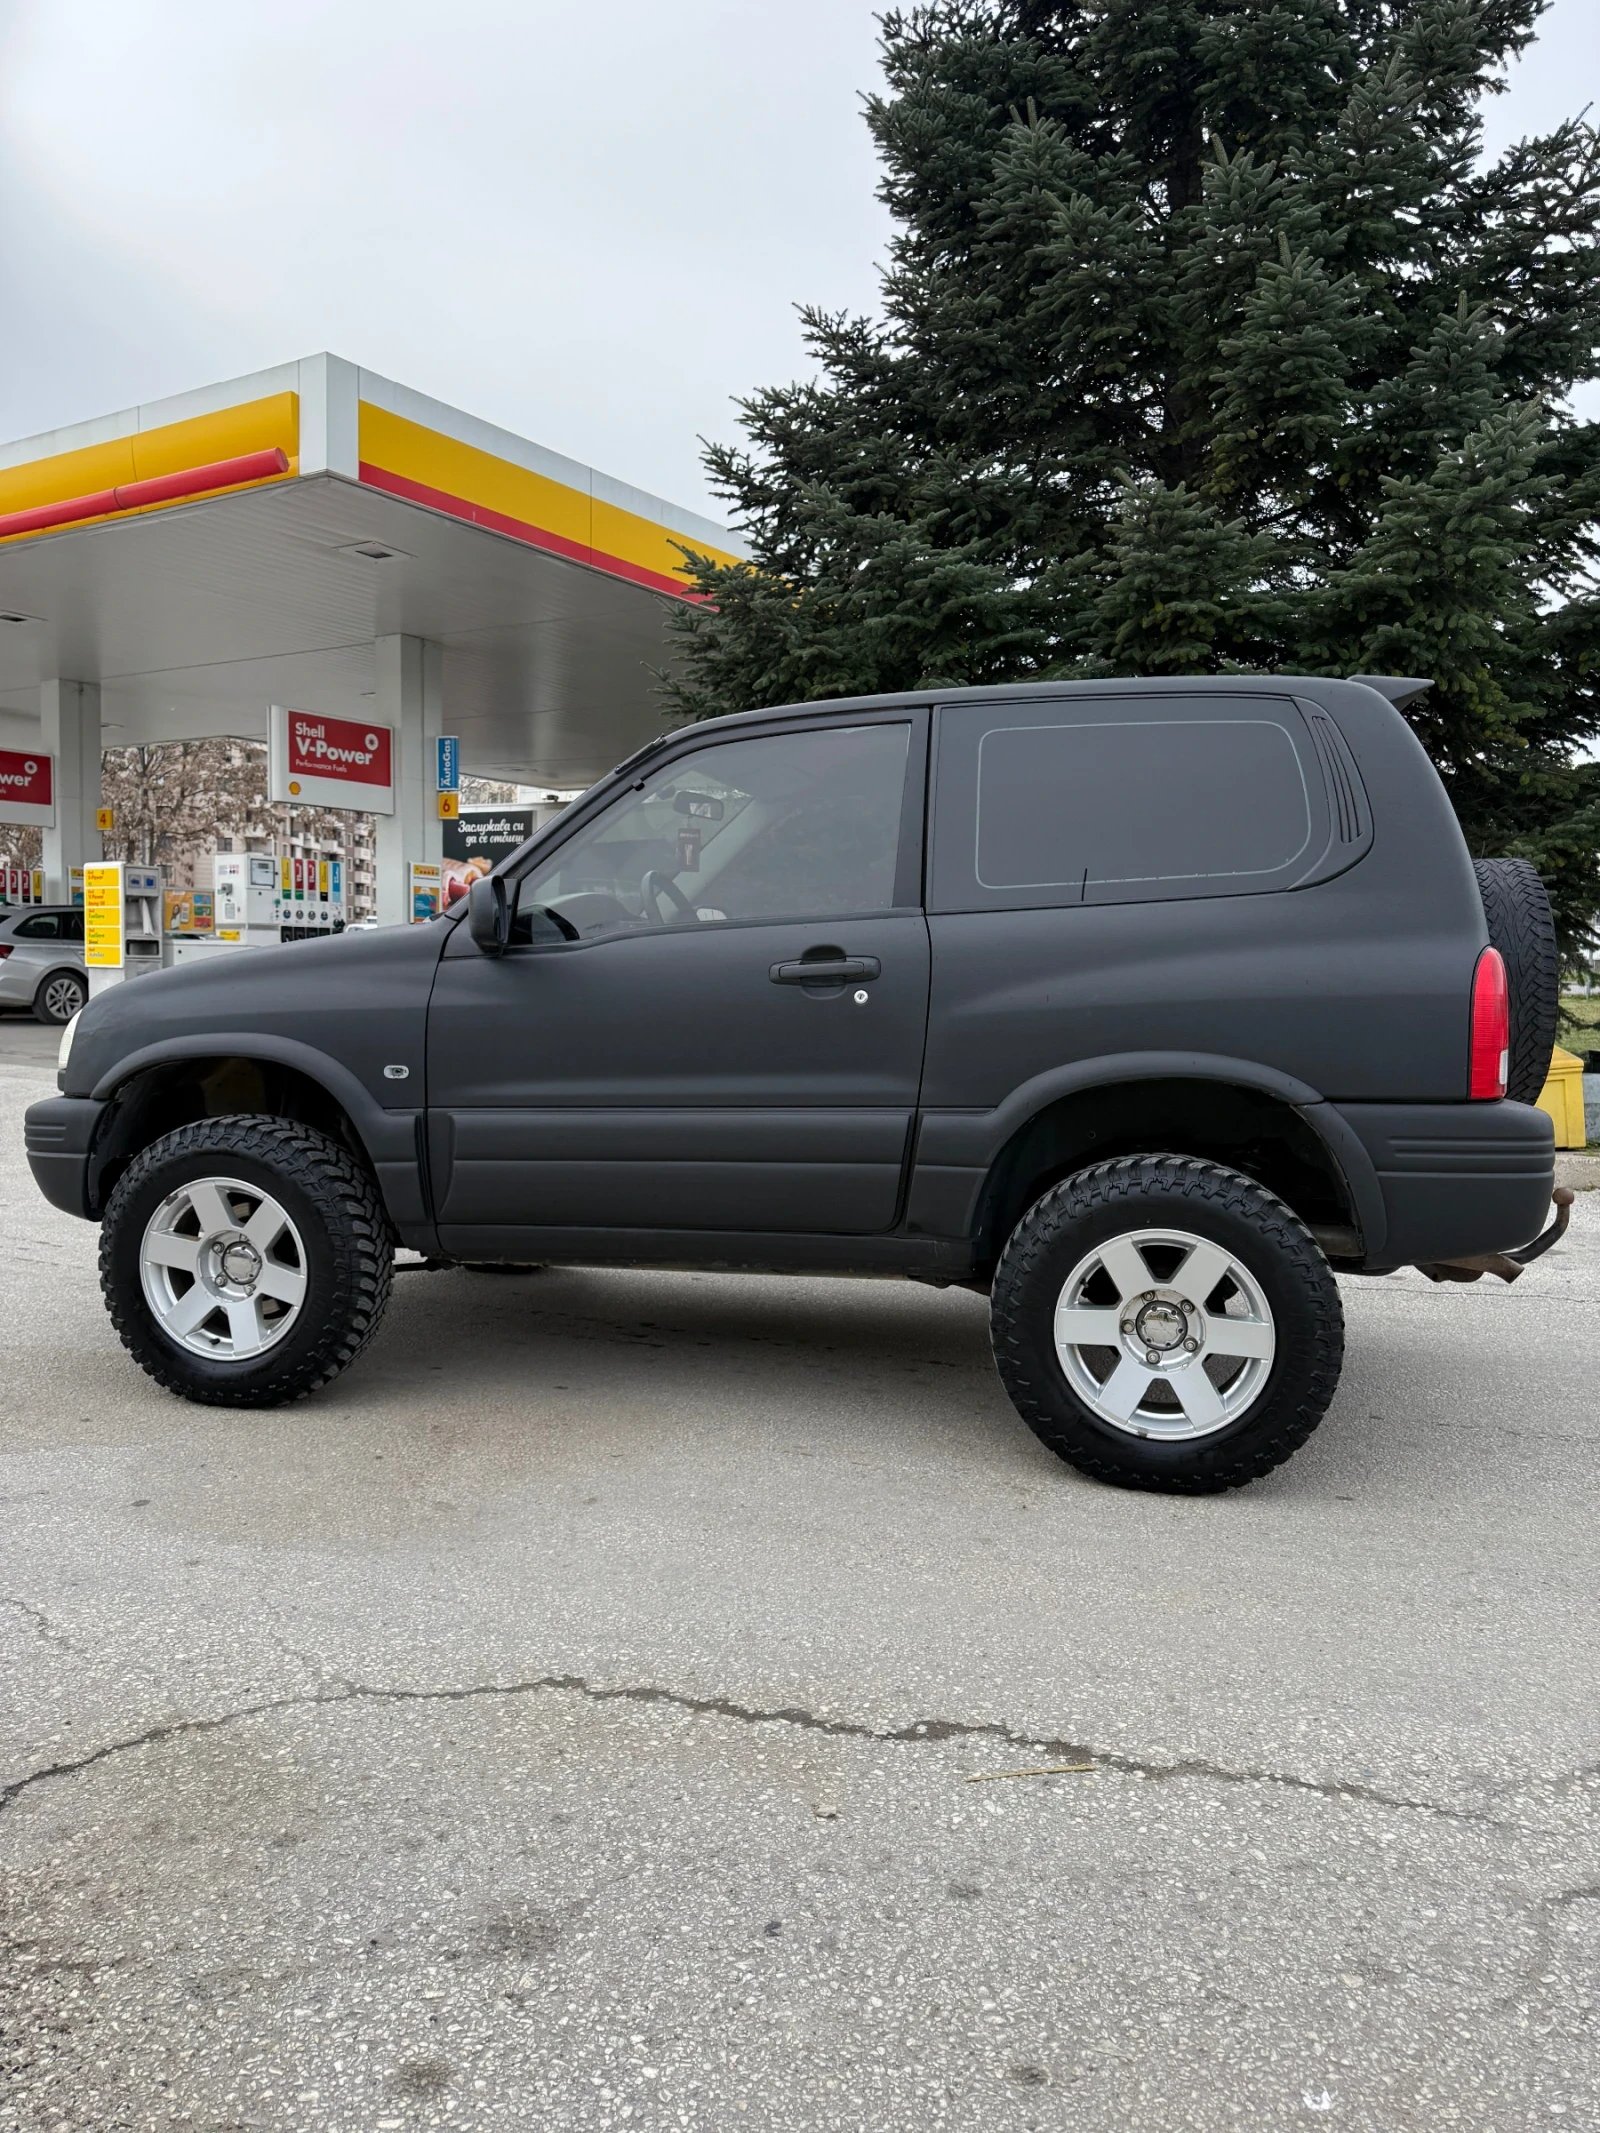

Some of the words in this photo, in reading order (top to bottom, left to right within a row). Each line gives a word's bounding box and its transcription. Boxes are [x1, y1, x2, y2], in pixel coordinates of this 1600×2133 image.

[295, 722, 325, 739] Shell
[296, 736, 373, 765] V-Power
[442, 739, 452, 786] AutoGas
[442, 799, 451, 813] 6
[100, 813, 106, 825] 4
[458, 818, 511, 835] Заслужава
[512, 822, 525, 832] си
[465, 835, 477, 847] да
[478, 834, 488, 844] се
